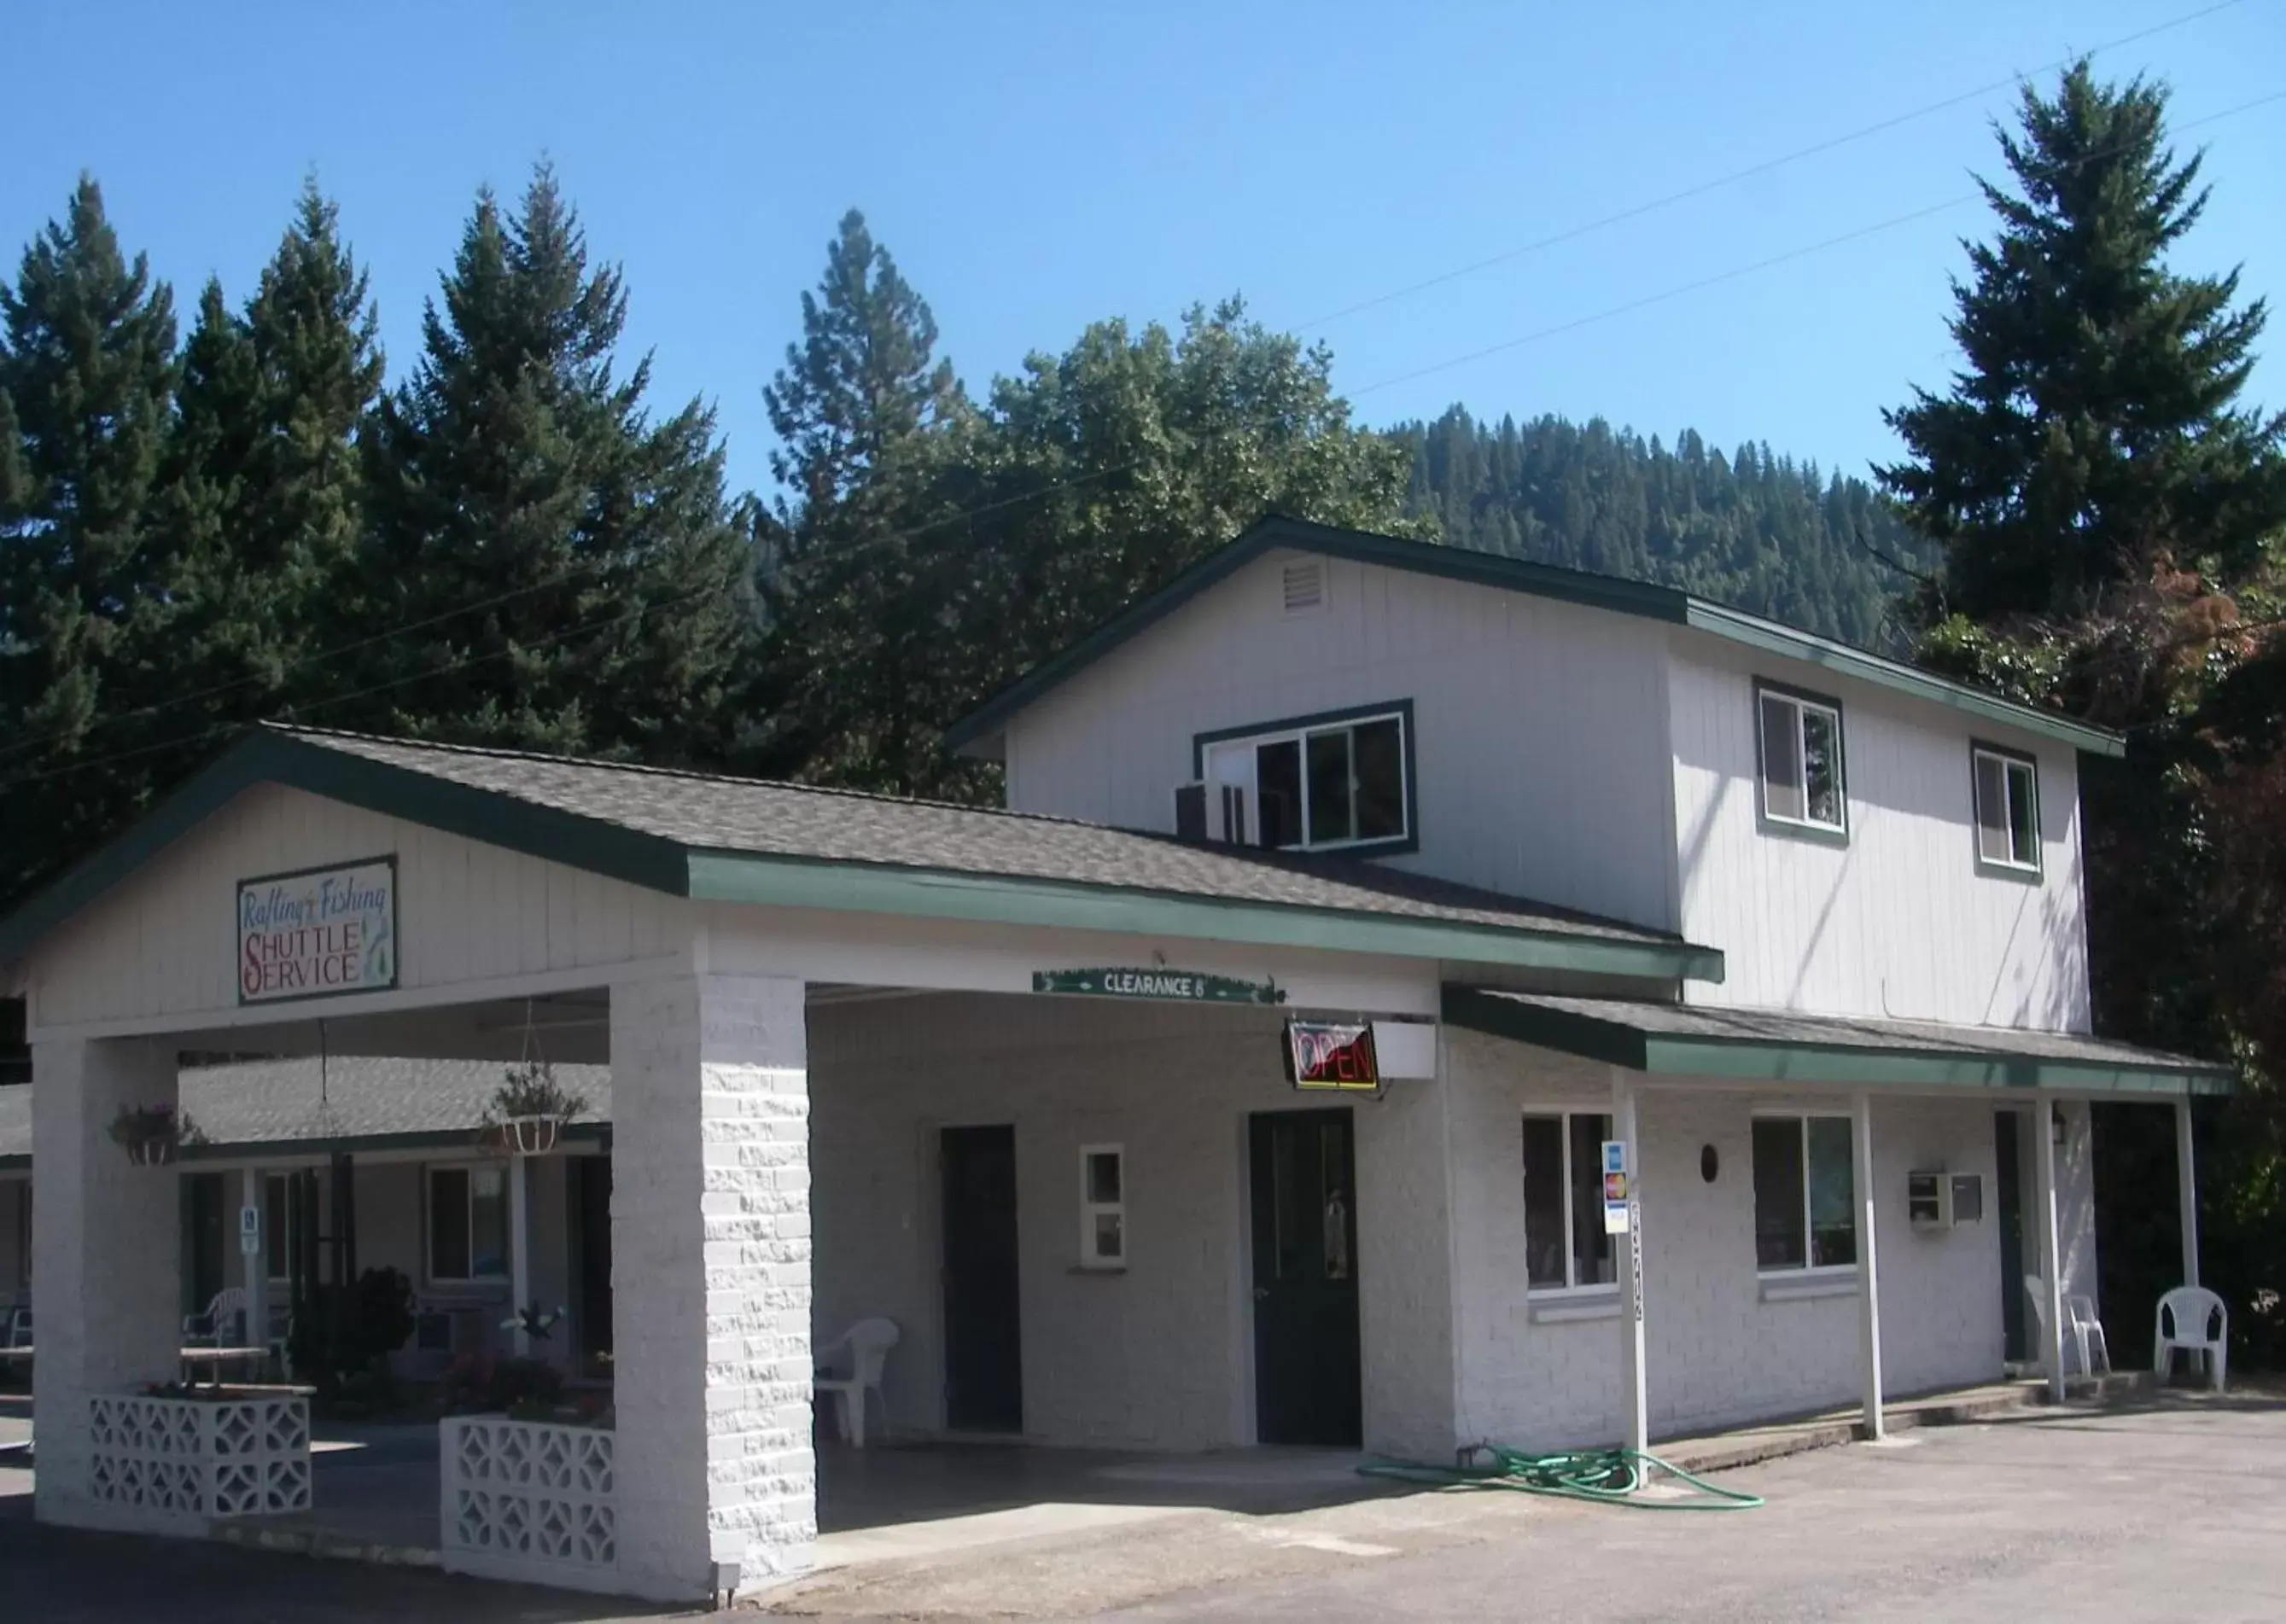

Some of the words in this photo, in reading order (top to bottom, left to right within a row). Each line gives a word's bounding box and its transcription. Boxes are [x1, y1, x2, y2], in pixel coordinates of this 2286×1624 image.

[319, 876, 386, 920] Fishing
[246, 922, 360, 966] SHUTTLE
[244, 952, 359, 995] SERVICE
[1105, 974, 1192, 996] CLEARANCE
[1298, 1032, 1371, 1080] OPEN
